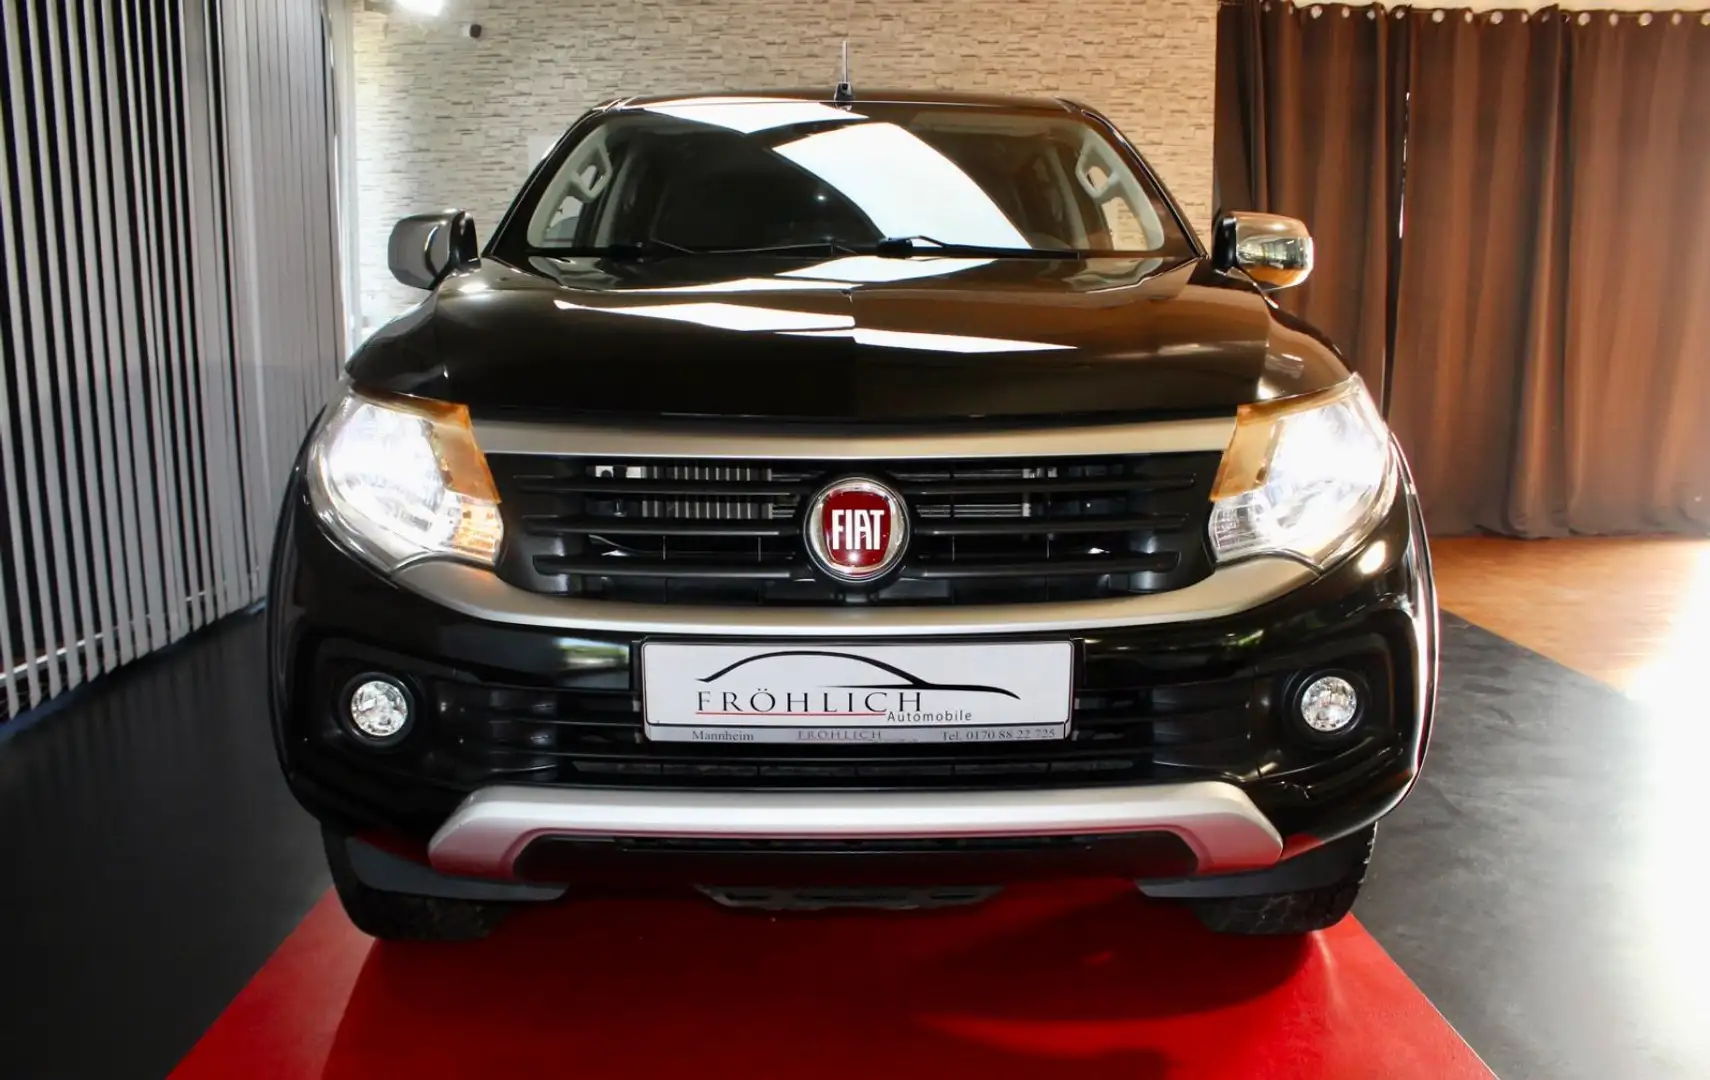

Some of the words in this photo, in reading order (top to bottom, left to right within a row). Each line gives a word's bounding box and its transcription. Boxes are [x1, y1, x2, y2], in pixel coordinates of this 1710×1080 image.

[832, 509, 885, 551] FIAT
[697, 688, 921, 713] FRÖHLICH
[887, 709, 972, 723] Automobile
[691, 730, 755, 742] Mannheim
[940, 730, 963, 742] Tel.
[966, 730, 995, 741] 0170
[1016, 728, 1031, 739] 22
[1035, 727, 1056, 739] 725
